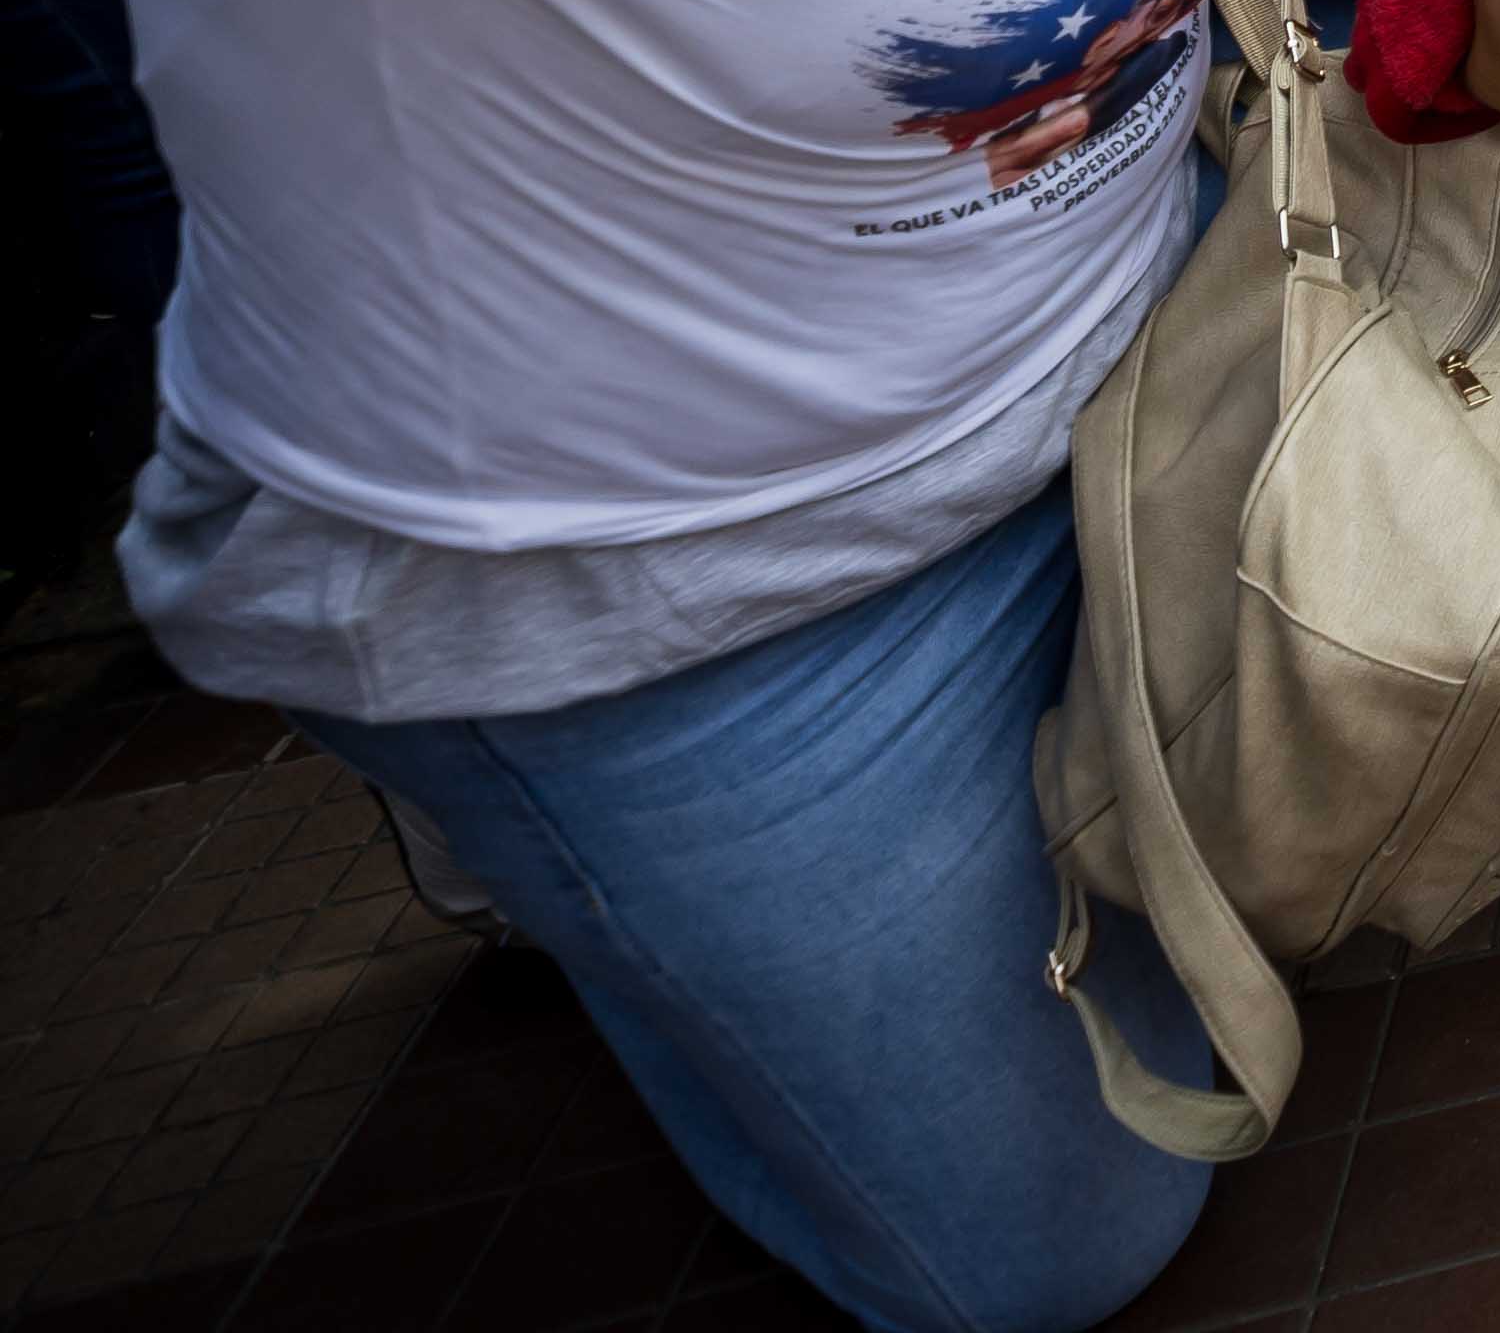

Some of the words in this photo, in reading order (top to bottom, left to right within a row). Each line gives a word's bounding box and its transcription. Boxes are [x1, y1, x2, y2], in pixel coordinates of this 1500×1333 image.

[890, 210, 945, 234] QUE
[950, 200, 985, 220] VA
[987, 174, 1041, 208] TRAS
[1043, 160, 1067, 181] LA
[1068, 109, 1142, 165] JUSTICIA
[1030, 122, 1147, 213] PROSPERIDAD
[1063, 130, 1161, 213] PROVERBIOS
